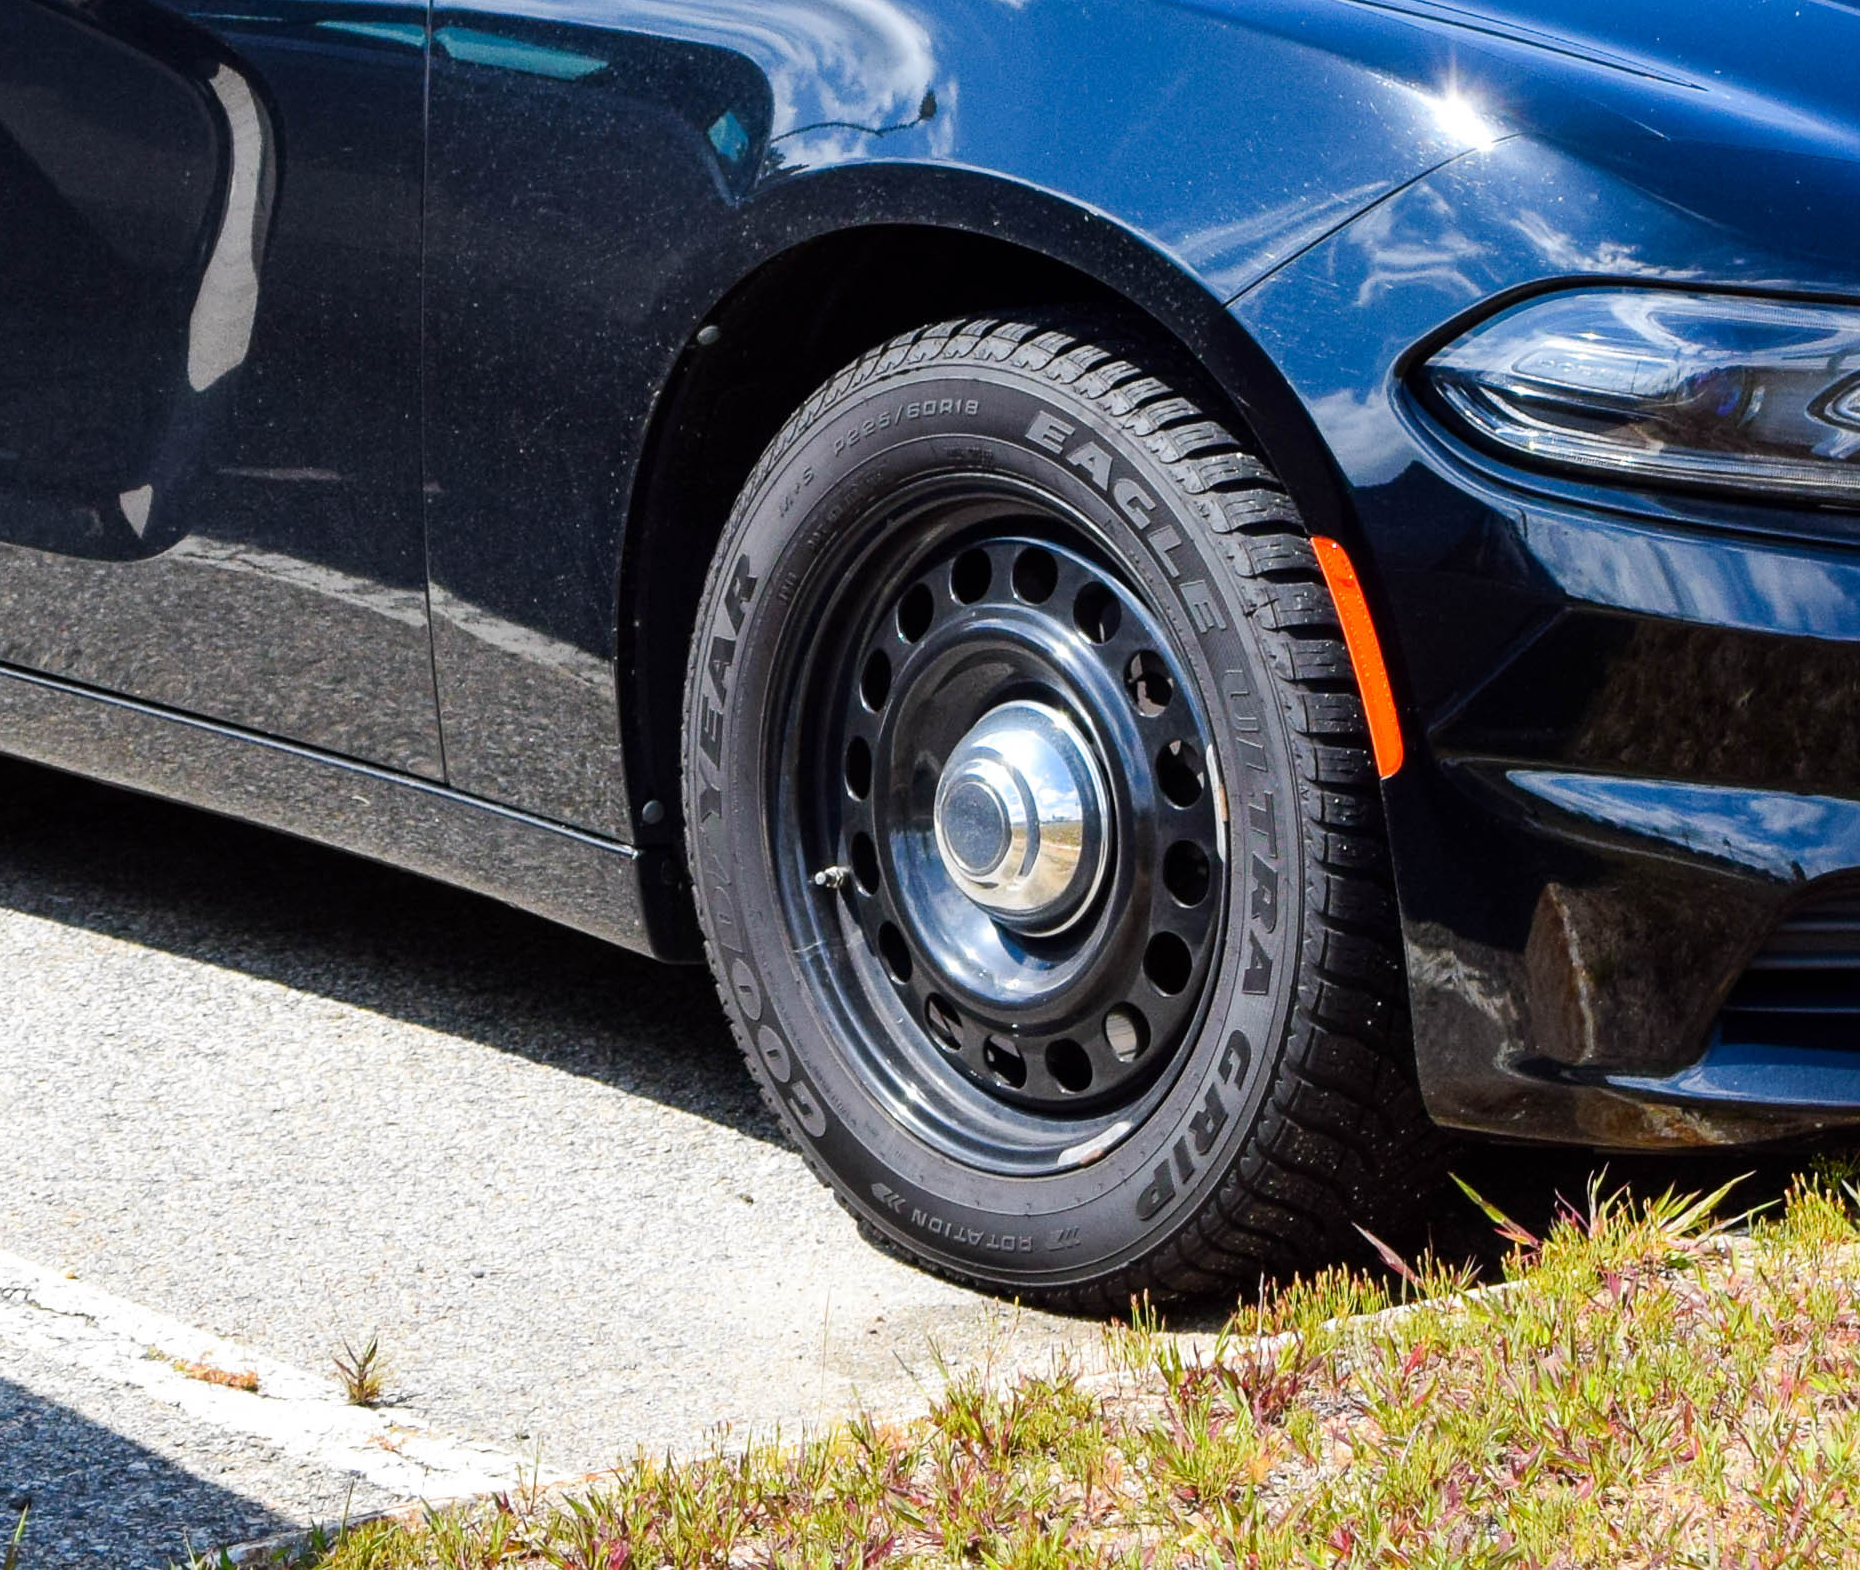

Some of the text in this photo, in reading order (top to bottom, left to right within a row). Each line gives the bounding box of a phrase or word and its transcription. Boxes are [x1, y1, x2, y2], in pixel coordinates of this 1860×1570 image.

[1025, 410, 1279, 1221] EAGLE ULTRA GRIP
[911, 1208, 1033, 1253] ROTATION
